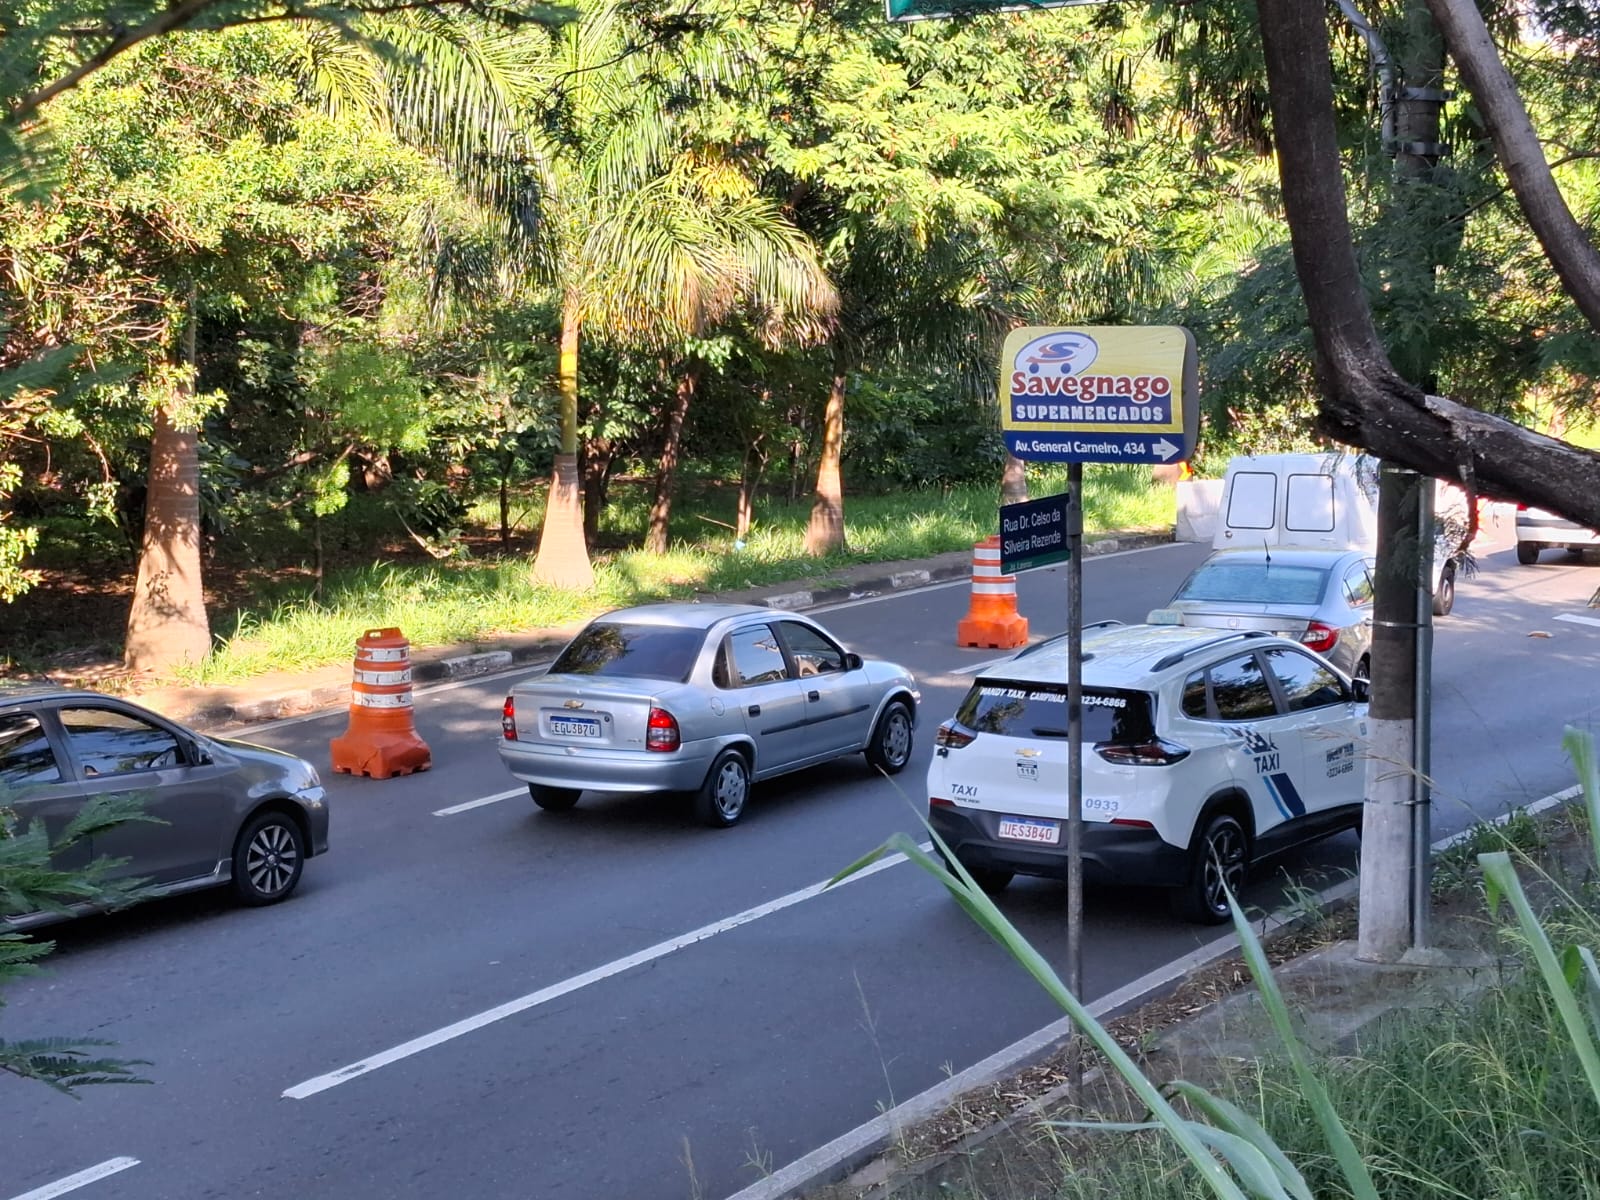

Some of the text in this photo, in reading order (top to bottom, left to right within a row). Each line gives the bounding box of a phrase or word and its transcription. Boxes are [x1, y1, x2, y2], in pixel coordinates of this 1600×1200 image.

[1011, 371, 1170, 402] Savegnago
[1016, 404, 1164, 421] SUPERMERCADOS
[1015, 440, 1146, 456] Av. General Carneiro, 434
[1003, 508, 1061, 533] Rua Dr. Celso da
[1004, 530, 1061, 555] Silveira Rezende
[1007, 689, 1026, 700] TAXI
[1029, 692, 1067, 704] CAMPINAS
[1253, 752, 1281, 774] TAXI
[951, 783, 978, 797] TAXI
[1085, 798, 1119, 812] 0933
